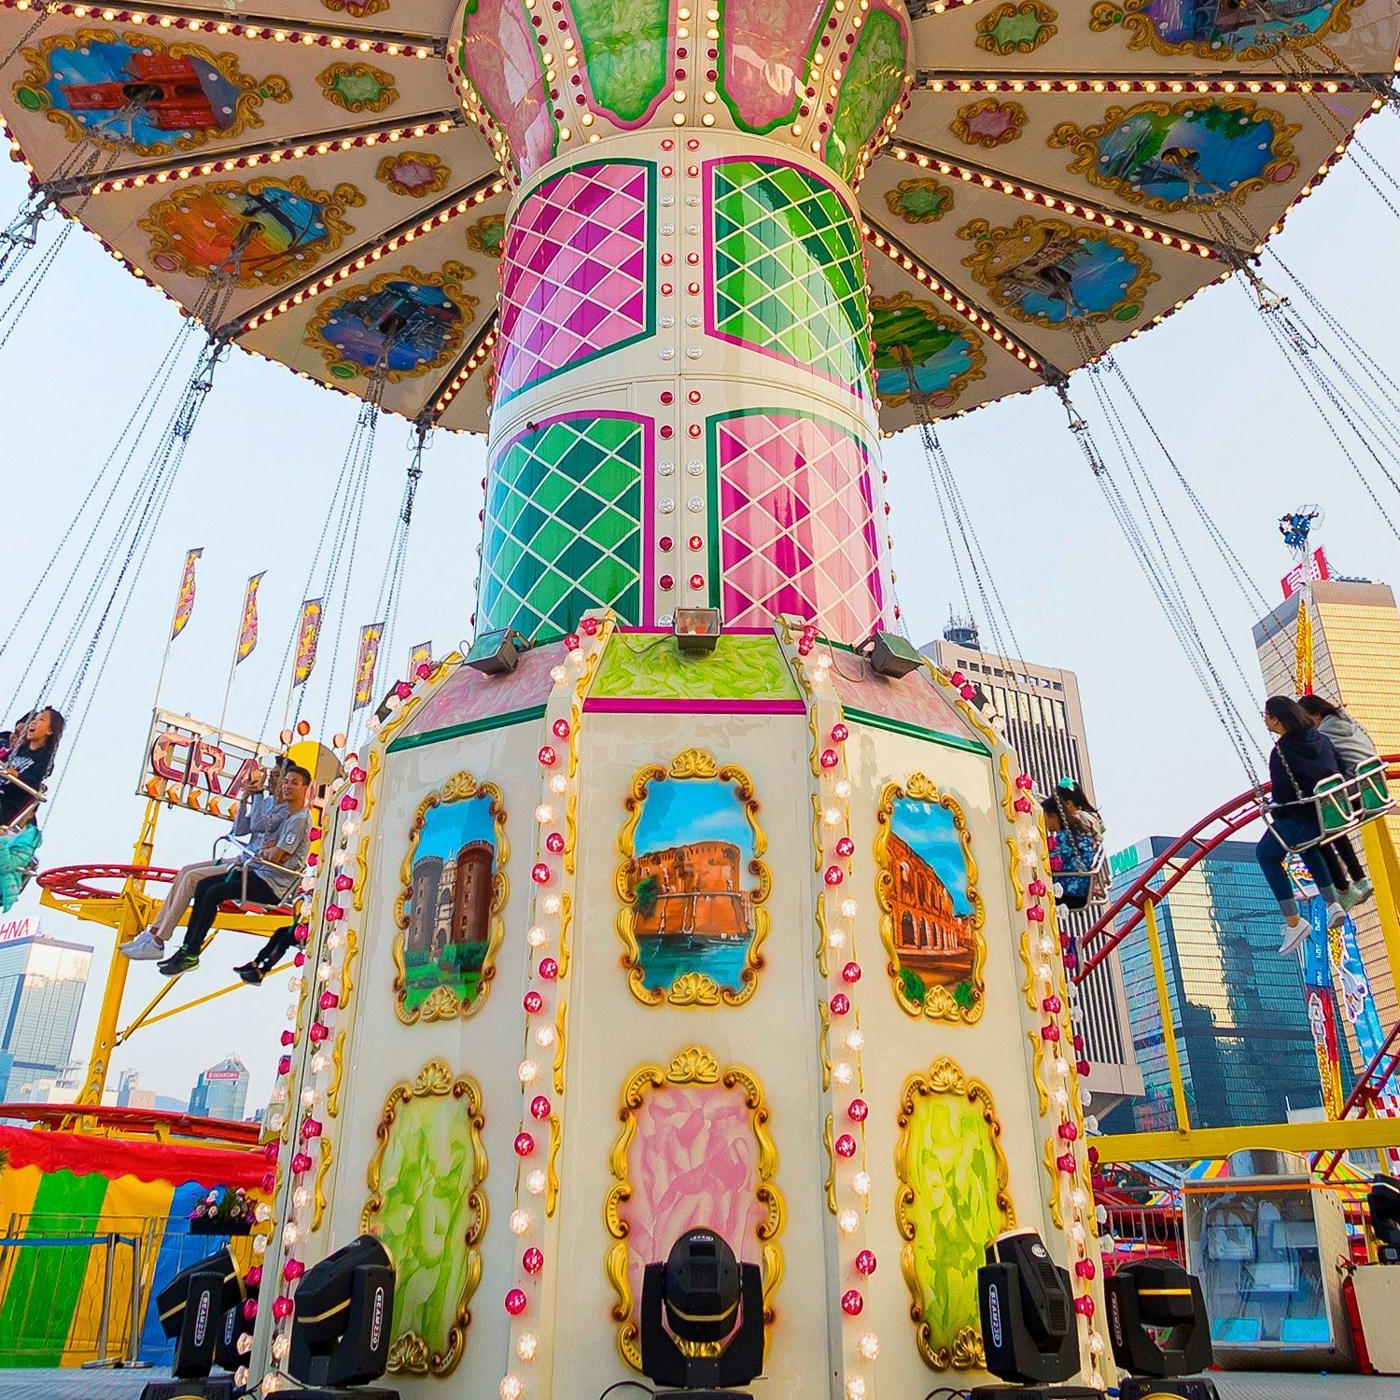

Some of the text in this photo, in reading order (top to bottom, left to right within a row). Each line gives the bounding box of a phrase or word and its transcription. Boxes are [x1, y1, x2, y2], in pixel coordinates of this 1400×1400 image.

[197, 1296, 208, 1341] BEAM230
[372, 1294, 383, 1344] BEAM230
[989, 1288, 1002, 1343] BEAM230
